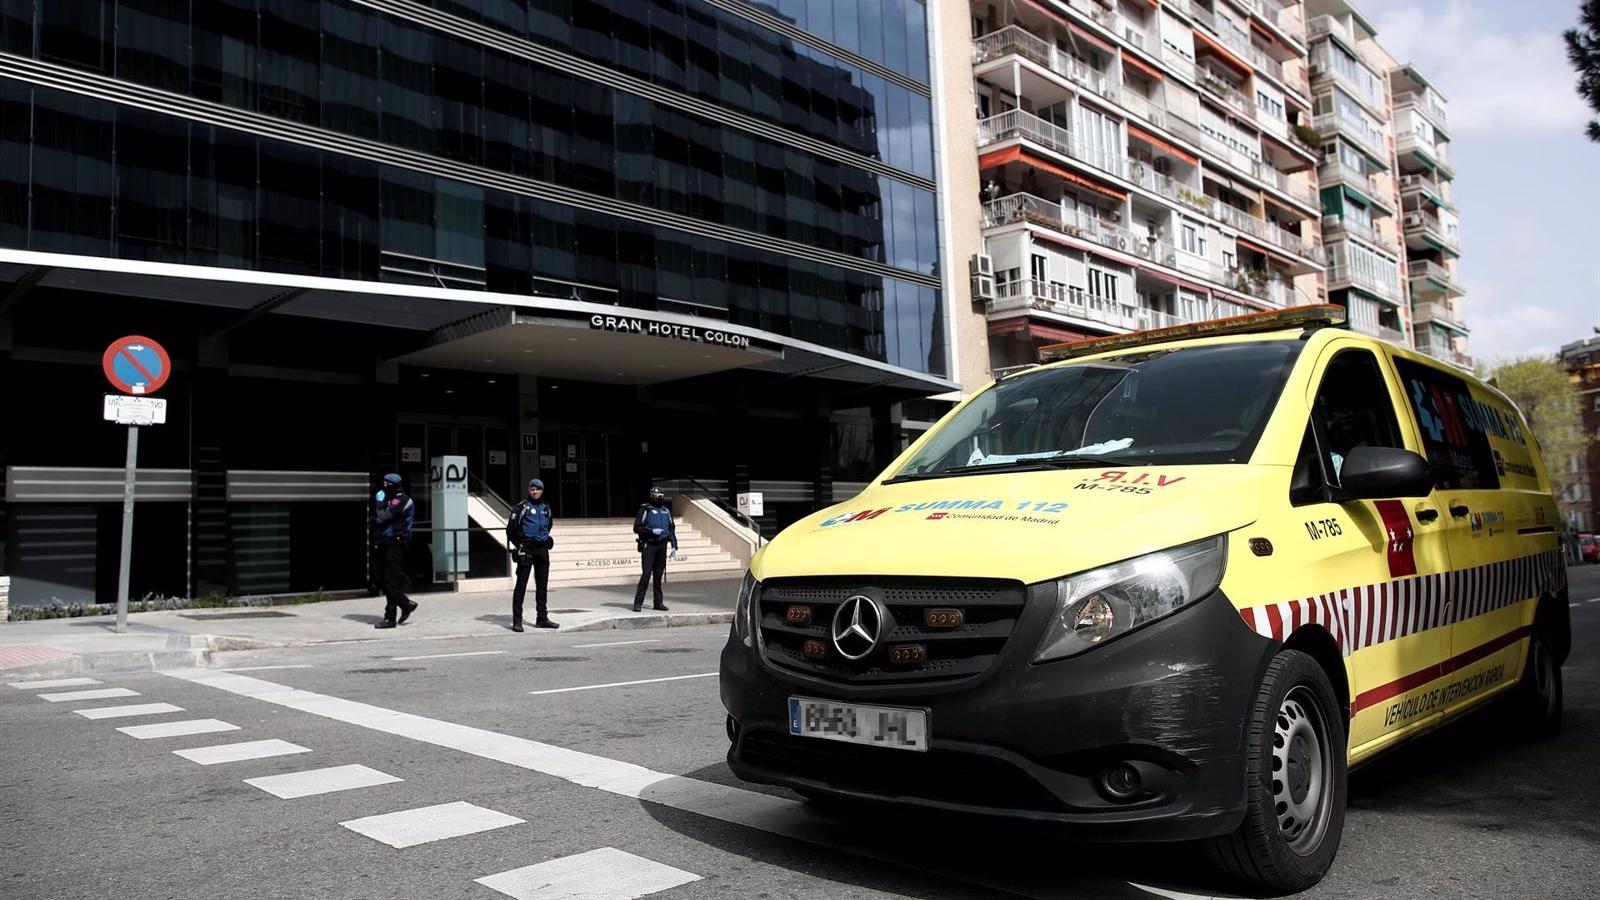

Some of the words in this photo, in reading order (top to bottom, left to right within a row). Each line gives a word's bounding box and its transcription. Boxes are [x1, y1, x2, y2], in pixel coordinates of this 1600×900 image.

[591, 315, 642, 331] GRAN
[649, 322, 701, 339] HOTEL
[704, 330, 750, 347] COLON
[1073, 483, 1152, 495] M-785
[895, 500, 1003, 513] SUMMA
[1016, 501, 1069, 513] 112
[1021, 516, 1060, 525] Madrid
[1304, 518, 1342, 541] M-785
[1384, 692, 1428, 727] VEHÍCULO
[1426, 689, 1440, 711] DE
